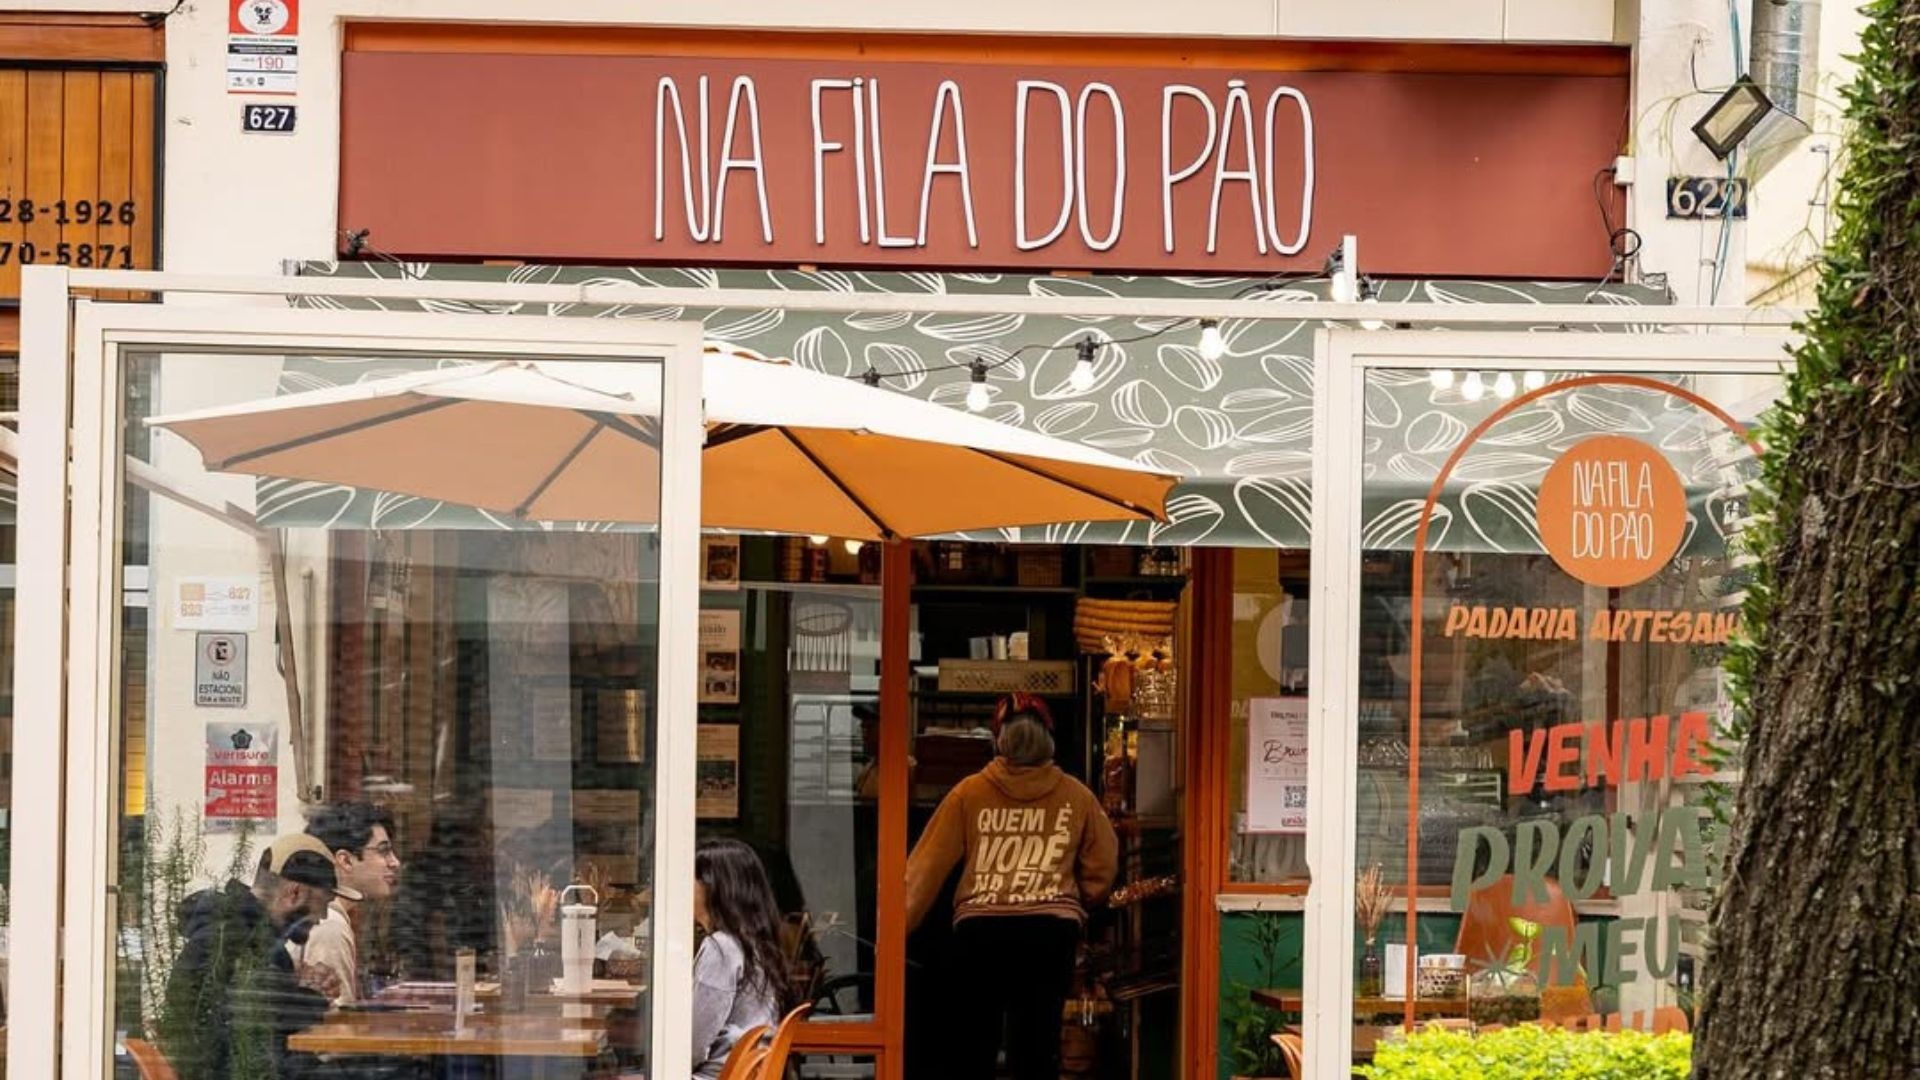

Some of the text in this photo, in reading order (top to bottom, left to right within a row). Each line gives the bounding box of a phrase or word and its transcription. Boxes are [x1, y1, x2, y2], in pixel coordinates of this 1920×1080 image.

[257, 56, 284, 69] 190
[249, 107, 290, 130] 627
[656, 75, 773, 243] NA
[1015, 80, 1127, 251] DO
[1162, 79, 1314, 255] PÃO
[1573, 460, 1654, 508] NA FILA
[1573, 511, 1604, 559] DO
[1444, 605, 1746, 646] PADARIA ARTESAN
[1507, 711, 1715, 796] VENHA
[210, 769, 272, 785] Alarme
[977, 807, 1046, 833] QUEM
[1537, 914, 1681, 991] MEU
